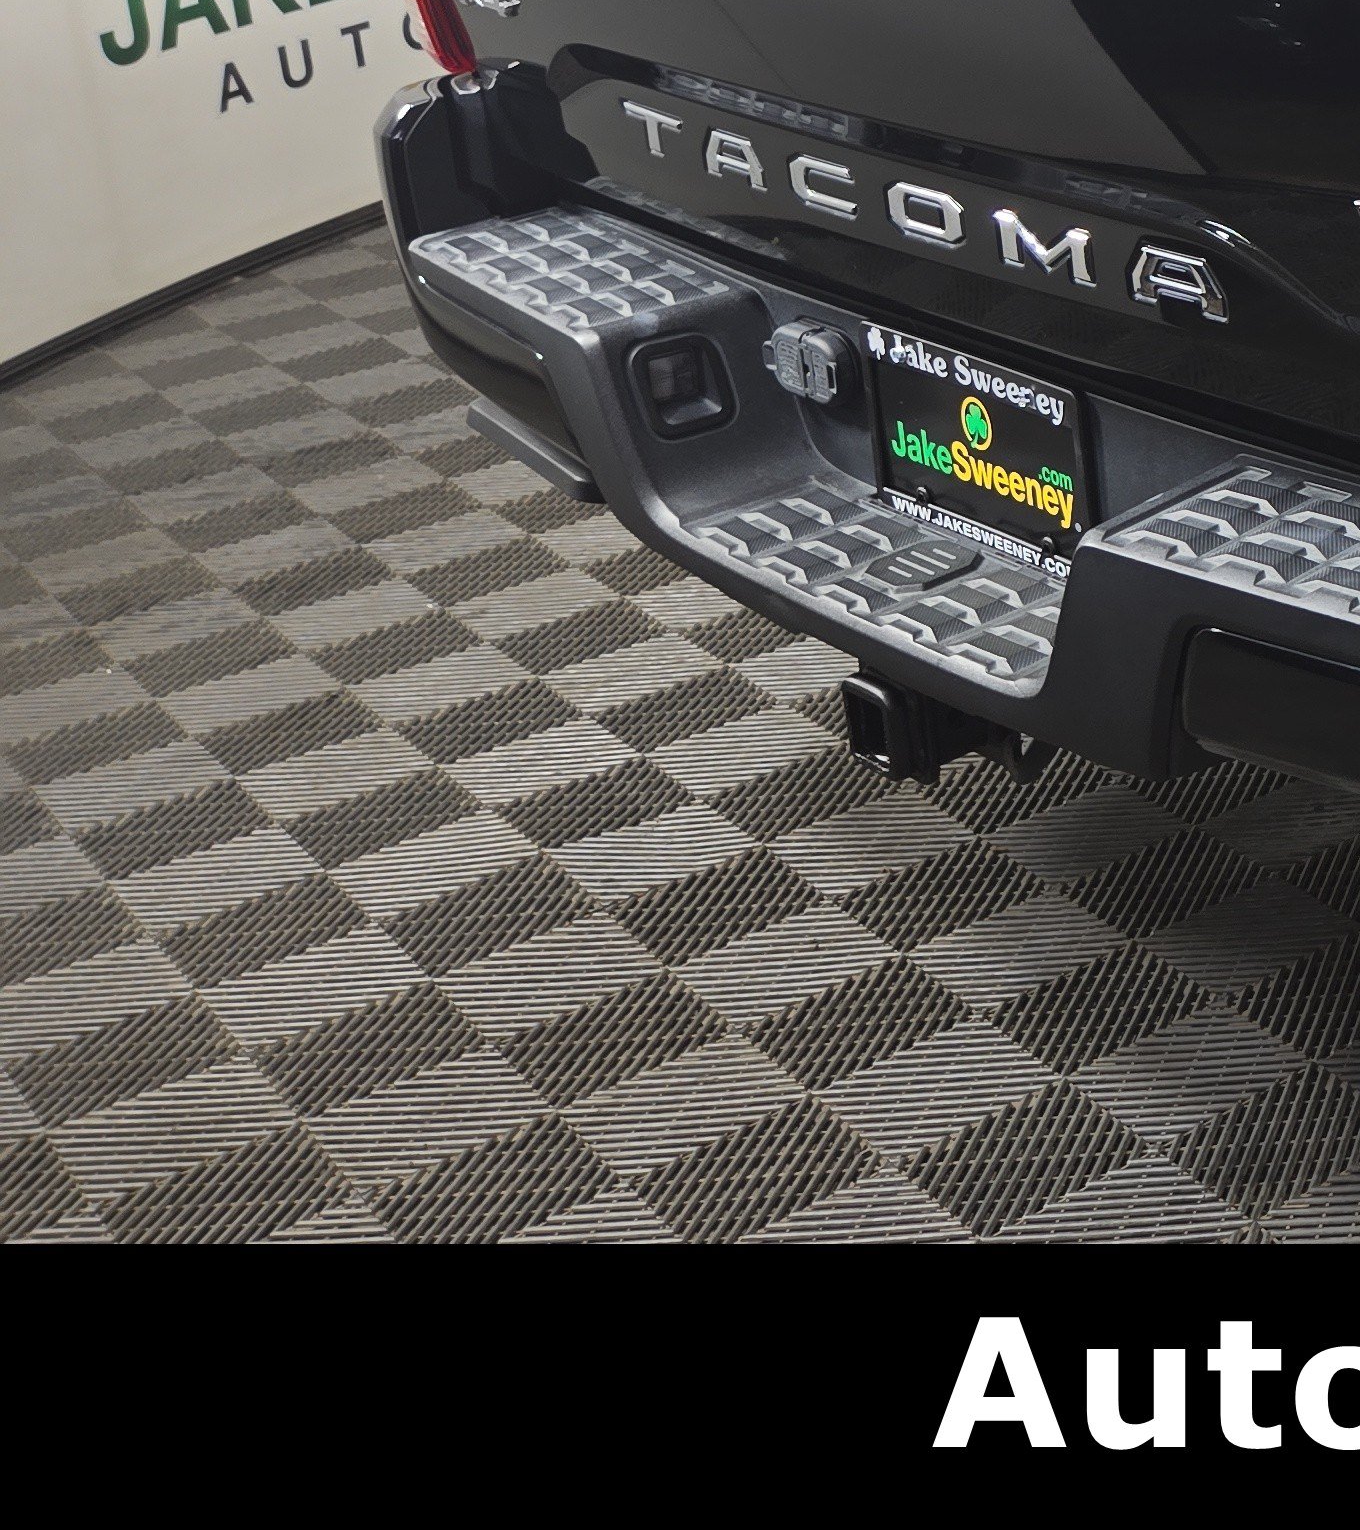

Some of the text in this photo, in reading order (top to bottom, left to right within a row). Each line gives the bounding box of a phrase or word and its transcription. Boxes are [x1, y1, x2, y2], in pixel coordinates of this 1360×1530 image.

[621, 98, 1231, 324] TACOMA
[889, 334, 949, 379] Jake
[953, 355, 1065, 426] Sweeney
